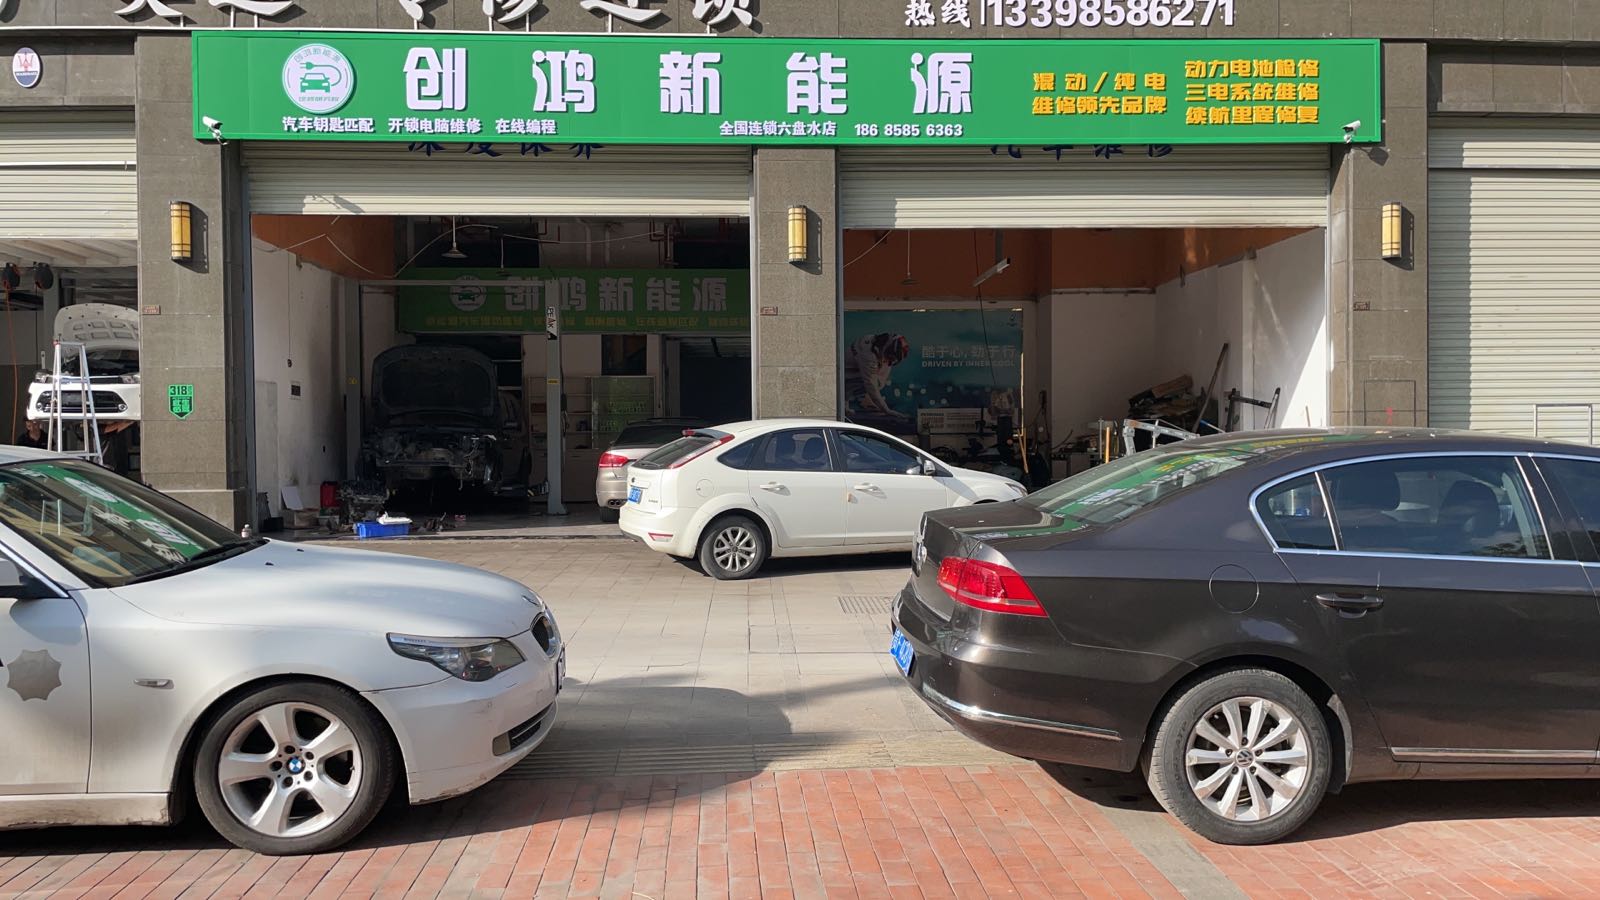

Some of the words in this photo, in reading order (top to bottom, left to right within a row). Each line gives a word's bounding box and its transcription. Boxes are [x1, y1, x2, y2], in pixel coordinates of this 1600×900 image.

[904, 0, 971, 28] 热线
[986, 0, 1236, 27] 13398586271
[1184, 59, 1320, 78] 动力电池检修
[402, 47, 973, 114] 创鸿新能源
[1032, 72, 1167, 93] 混动/纯电
[1184, 82, 1319, 101] 三电系统维修
[1032, 96, 1168, 114] 维修领先品牌
[1184, 105, 1319, 125] 续航里程修复
[282, 116, 374, 133] 汽车钥匙匹配
[388, 118, 482, 134] 开锁电脑维修
[495, 118, 557, 135] 在线编程
[719, 120, 837, 136] 全国连锁六盘水店
[854, 123, 878, 136] 186
[884, 123, 920, 137] 8585
[926, 123, 963, 136] 6363
[921, 360, 952, 368] DRIVEN
[953, 360, 963, 368] BY
[170, 385, 187, 395] 318
